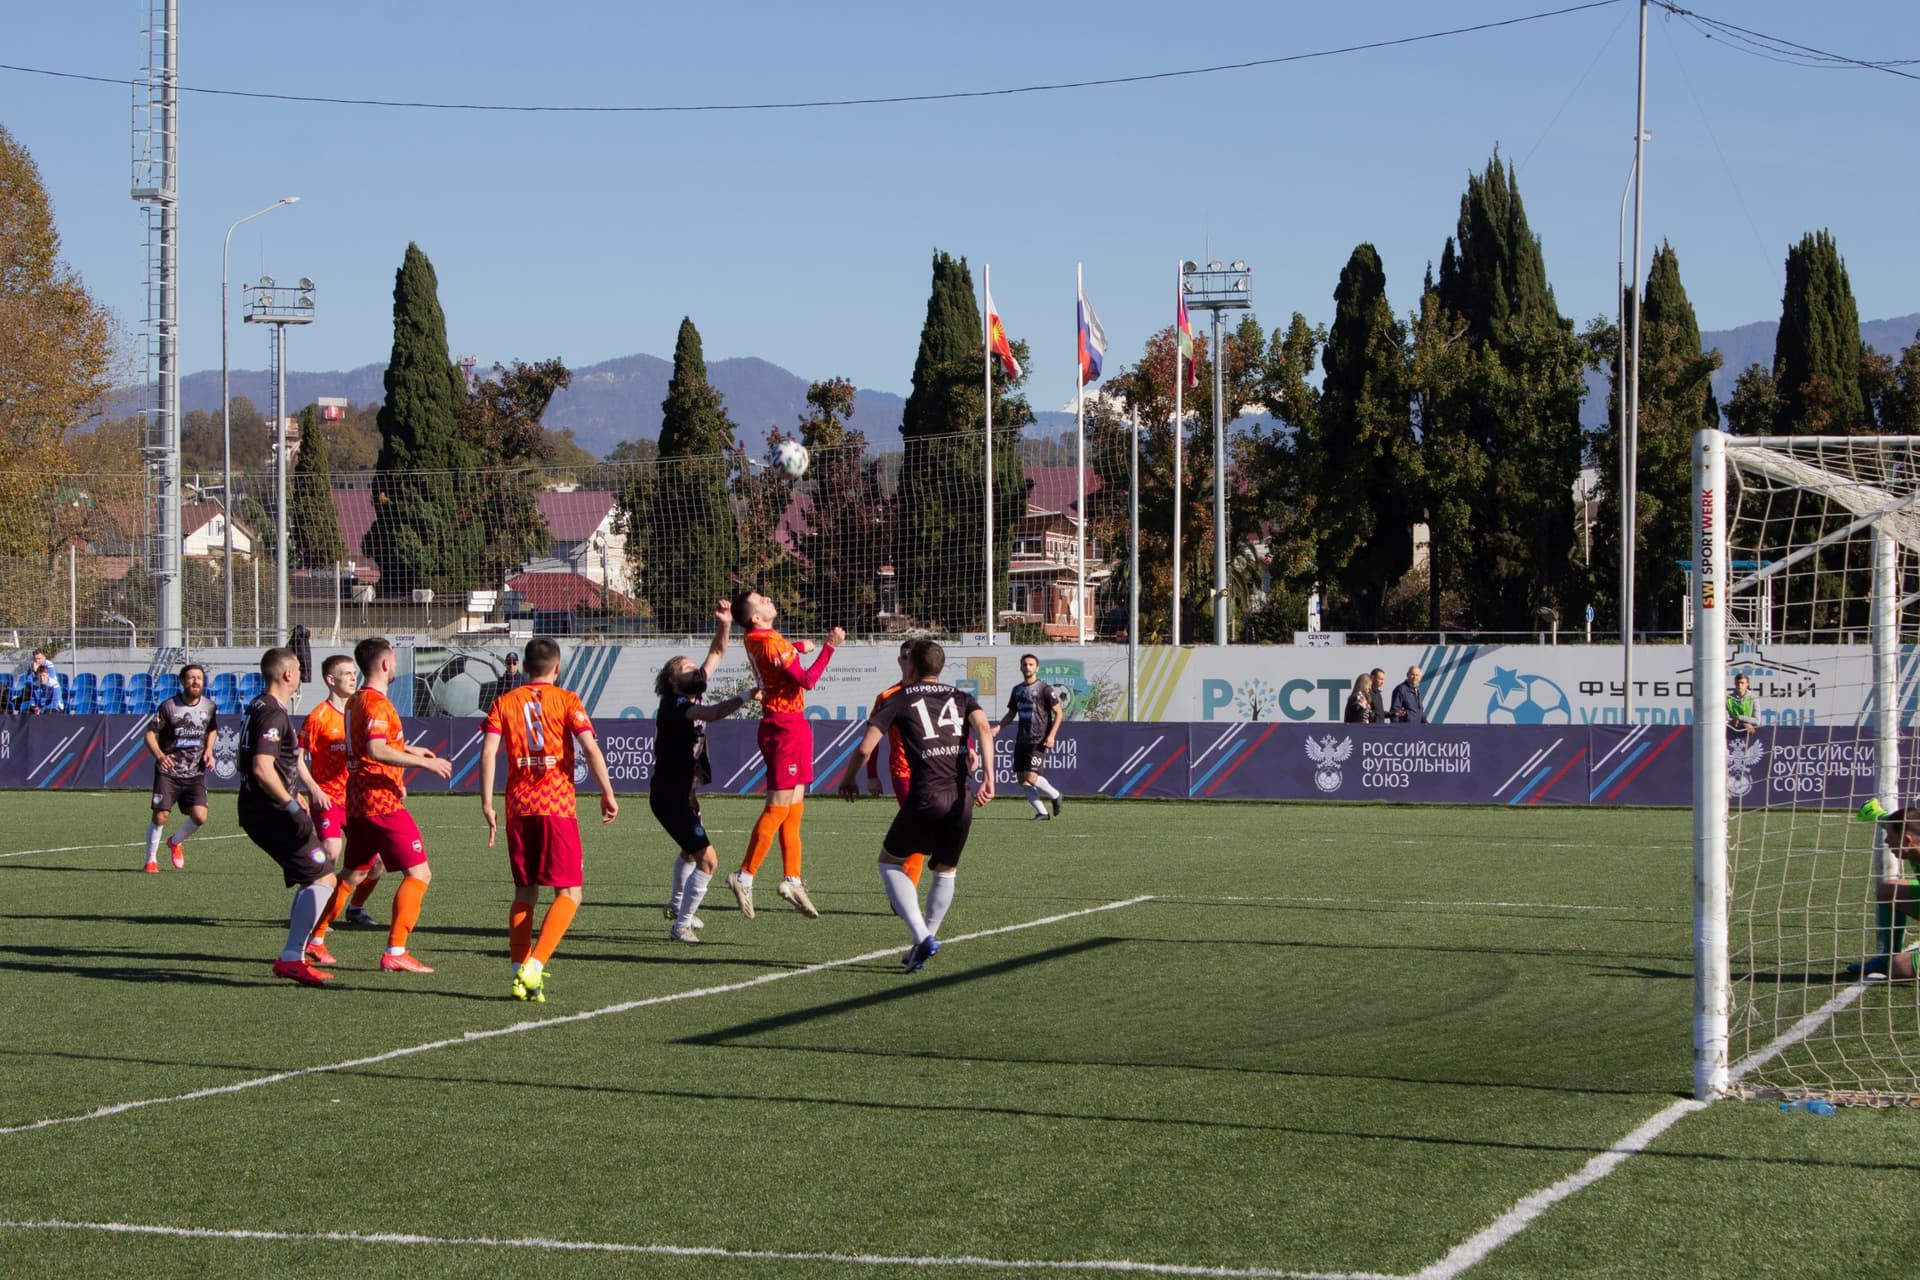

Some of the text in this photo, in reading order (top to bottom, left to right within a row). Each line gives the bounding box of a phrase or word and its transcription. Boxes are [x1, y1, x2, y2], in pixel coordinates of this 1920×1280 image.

[1702, 489, 1713, 575] SPORTWERK
[523, 700, 545, 751] 6
[911, 696, 964, 740] 14
[606, 736, 654, 750] РОССИ
[1362, 741, 1471, 757] РОССИЙСКИЙ
[606, 750, 656, 765] ФУТБО
[1772, 744, 1875, 760] РОССИЙСКИ
[1031, 756, 1042, 767] 89
[1362, 757, 1471, 773] ФУТБОЛЬНЫЙ
[1773, 760, 1875, 777] ФУТБОЛЬНЫ
[607, 766, 649, 779] СОЮЗ
[974, 769, 1019, 783] СЮЗ
[1362, 773, 1410, 788] СОЮЗ
[1773, 777, 1824, 792] СОЮЗ
